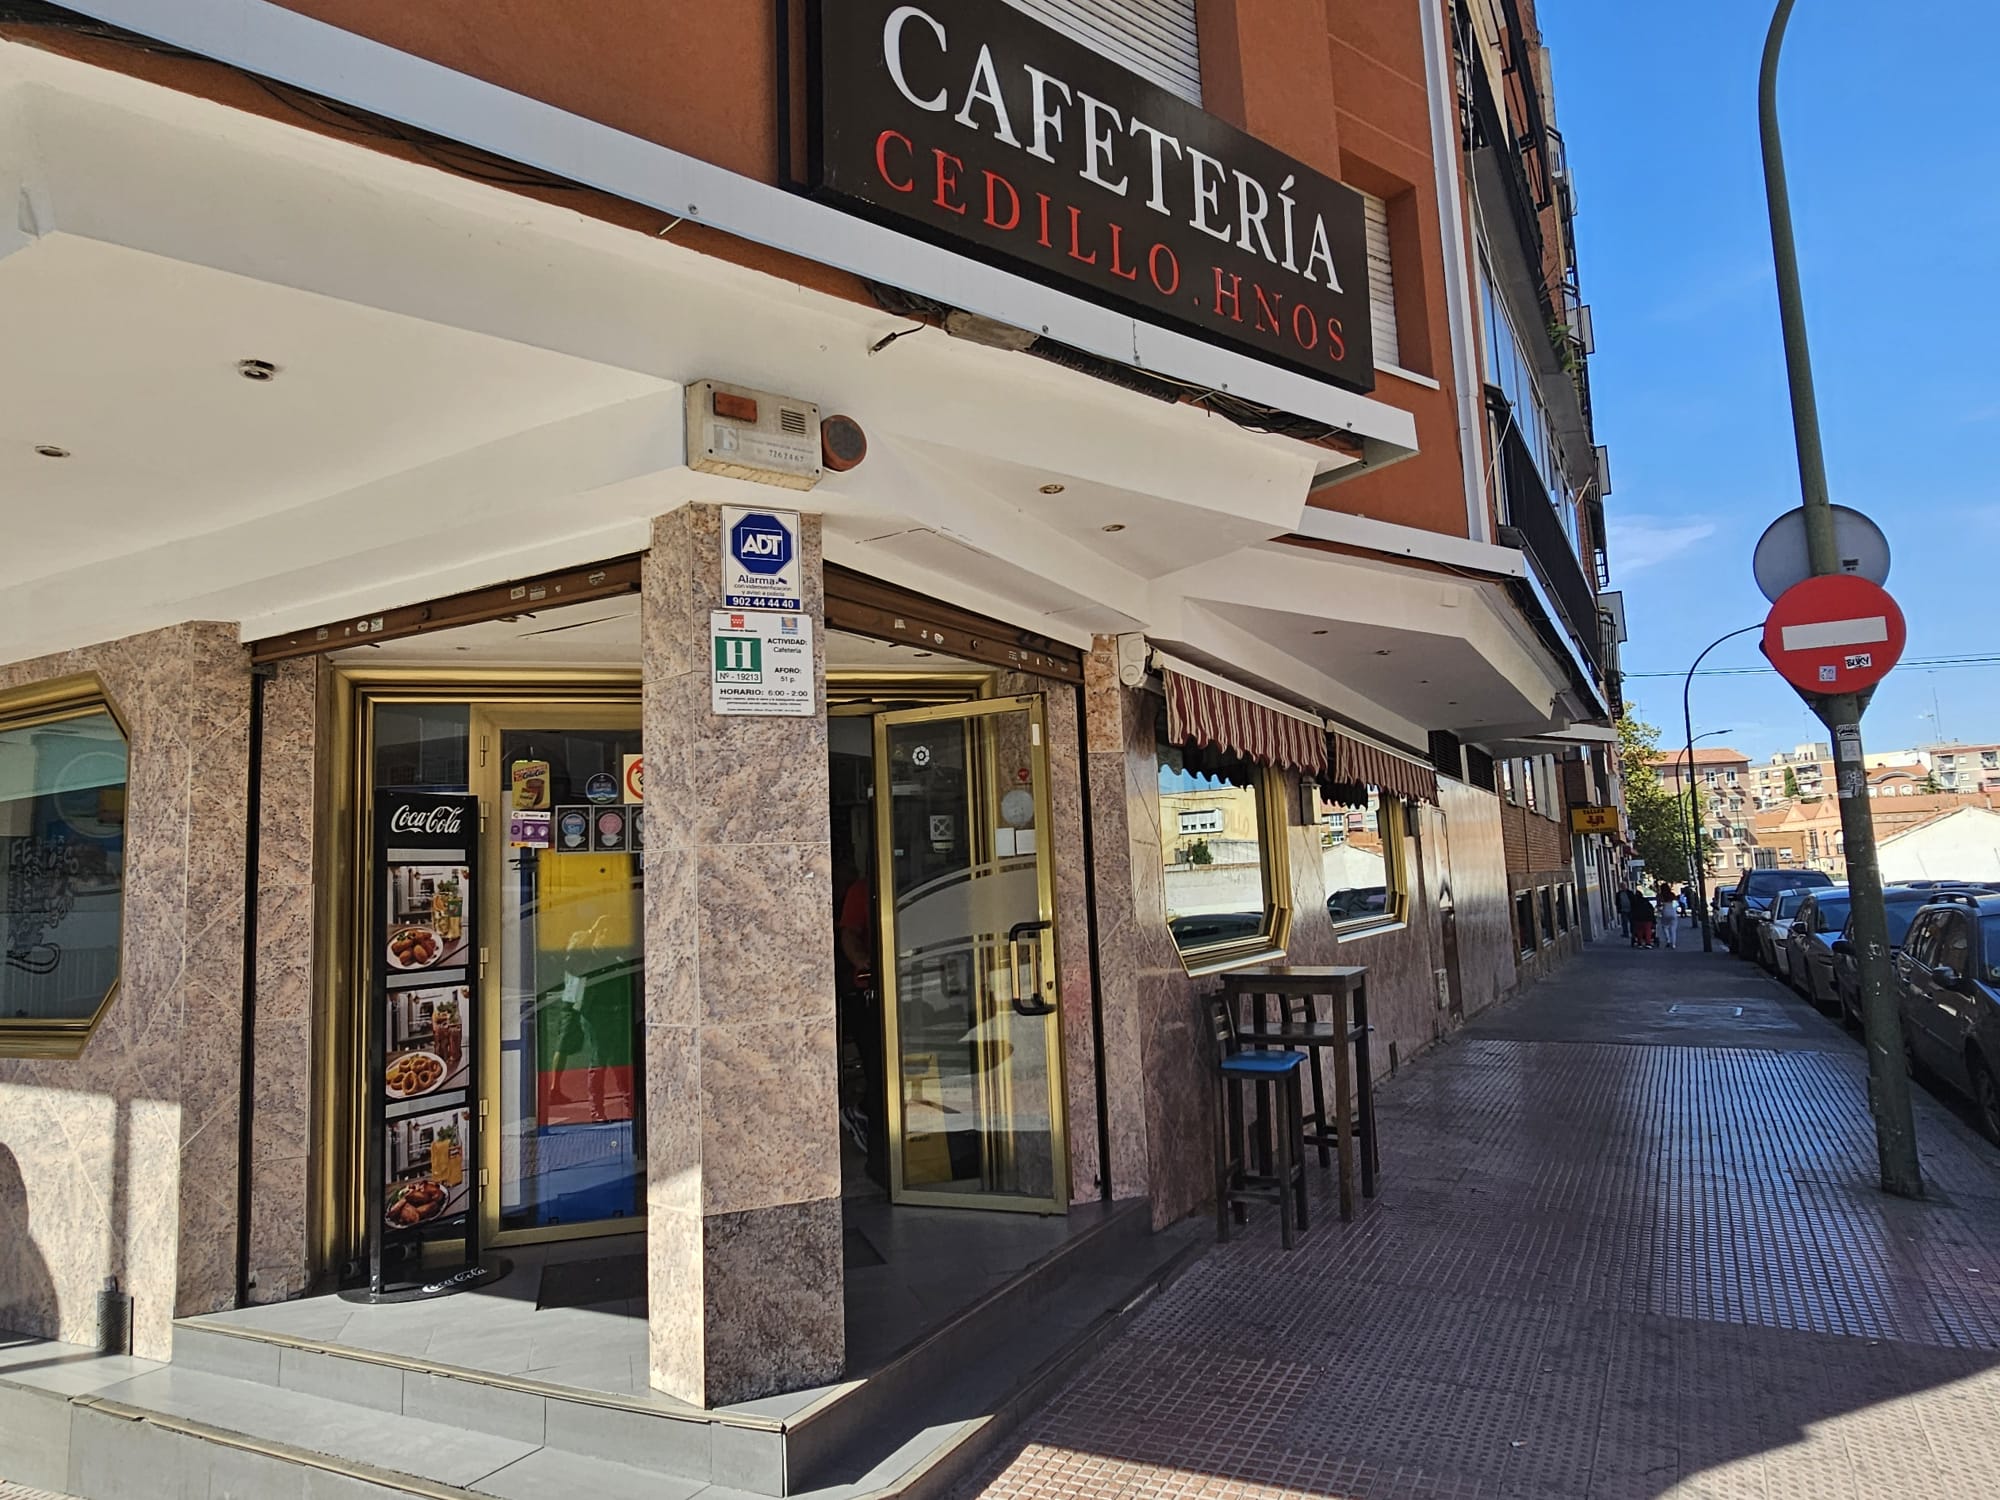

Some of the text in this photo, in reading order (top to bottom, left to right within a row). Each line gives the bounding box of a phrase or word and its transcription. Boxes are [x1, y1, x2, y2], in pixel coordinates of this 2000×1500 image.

[883, 6, 1344, 294] CAFETERÍA
[742, 533, 782, 556] ADT
[738, 575, 775, 585] Alarma
[733, 597, 794, 608] 902 44 44 40
[724, 640, 753, 669] H
[391, 804, 464, 833] Coca-Cola
